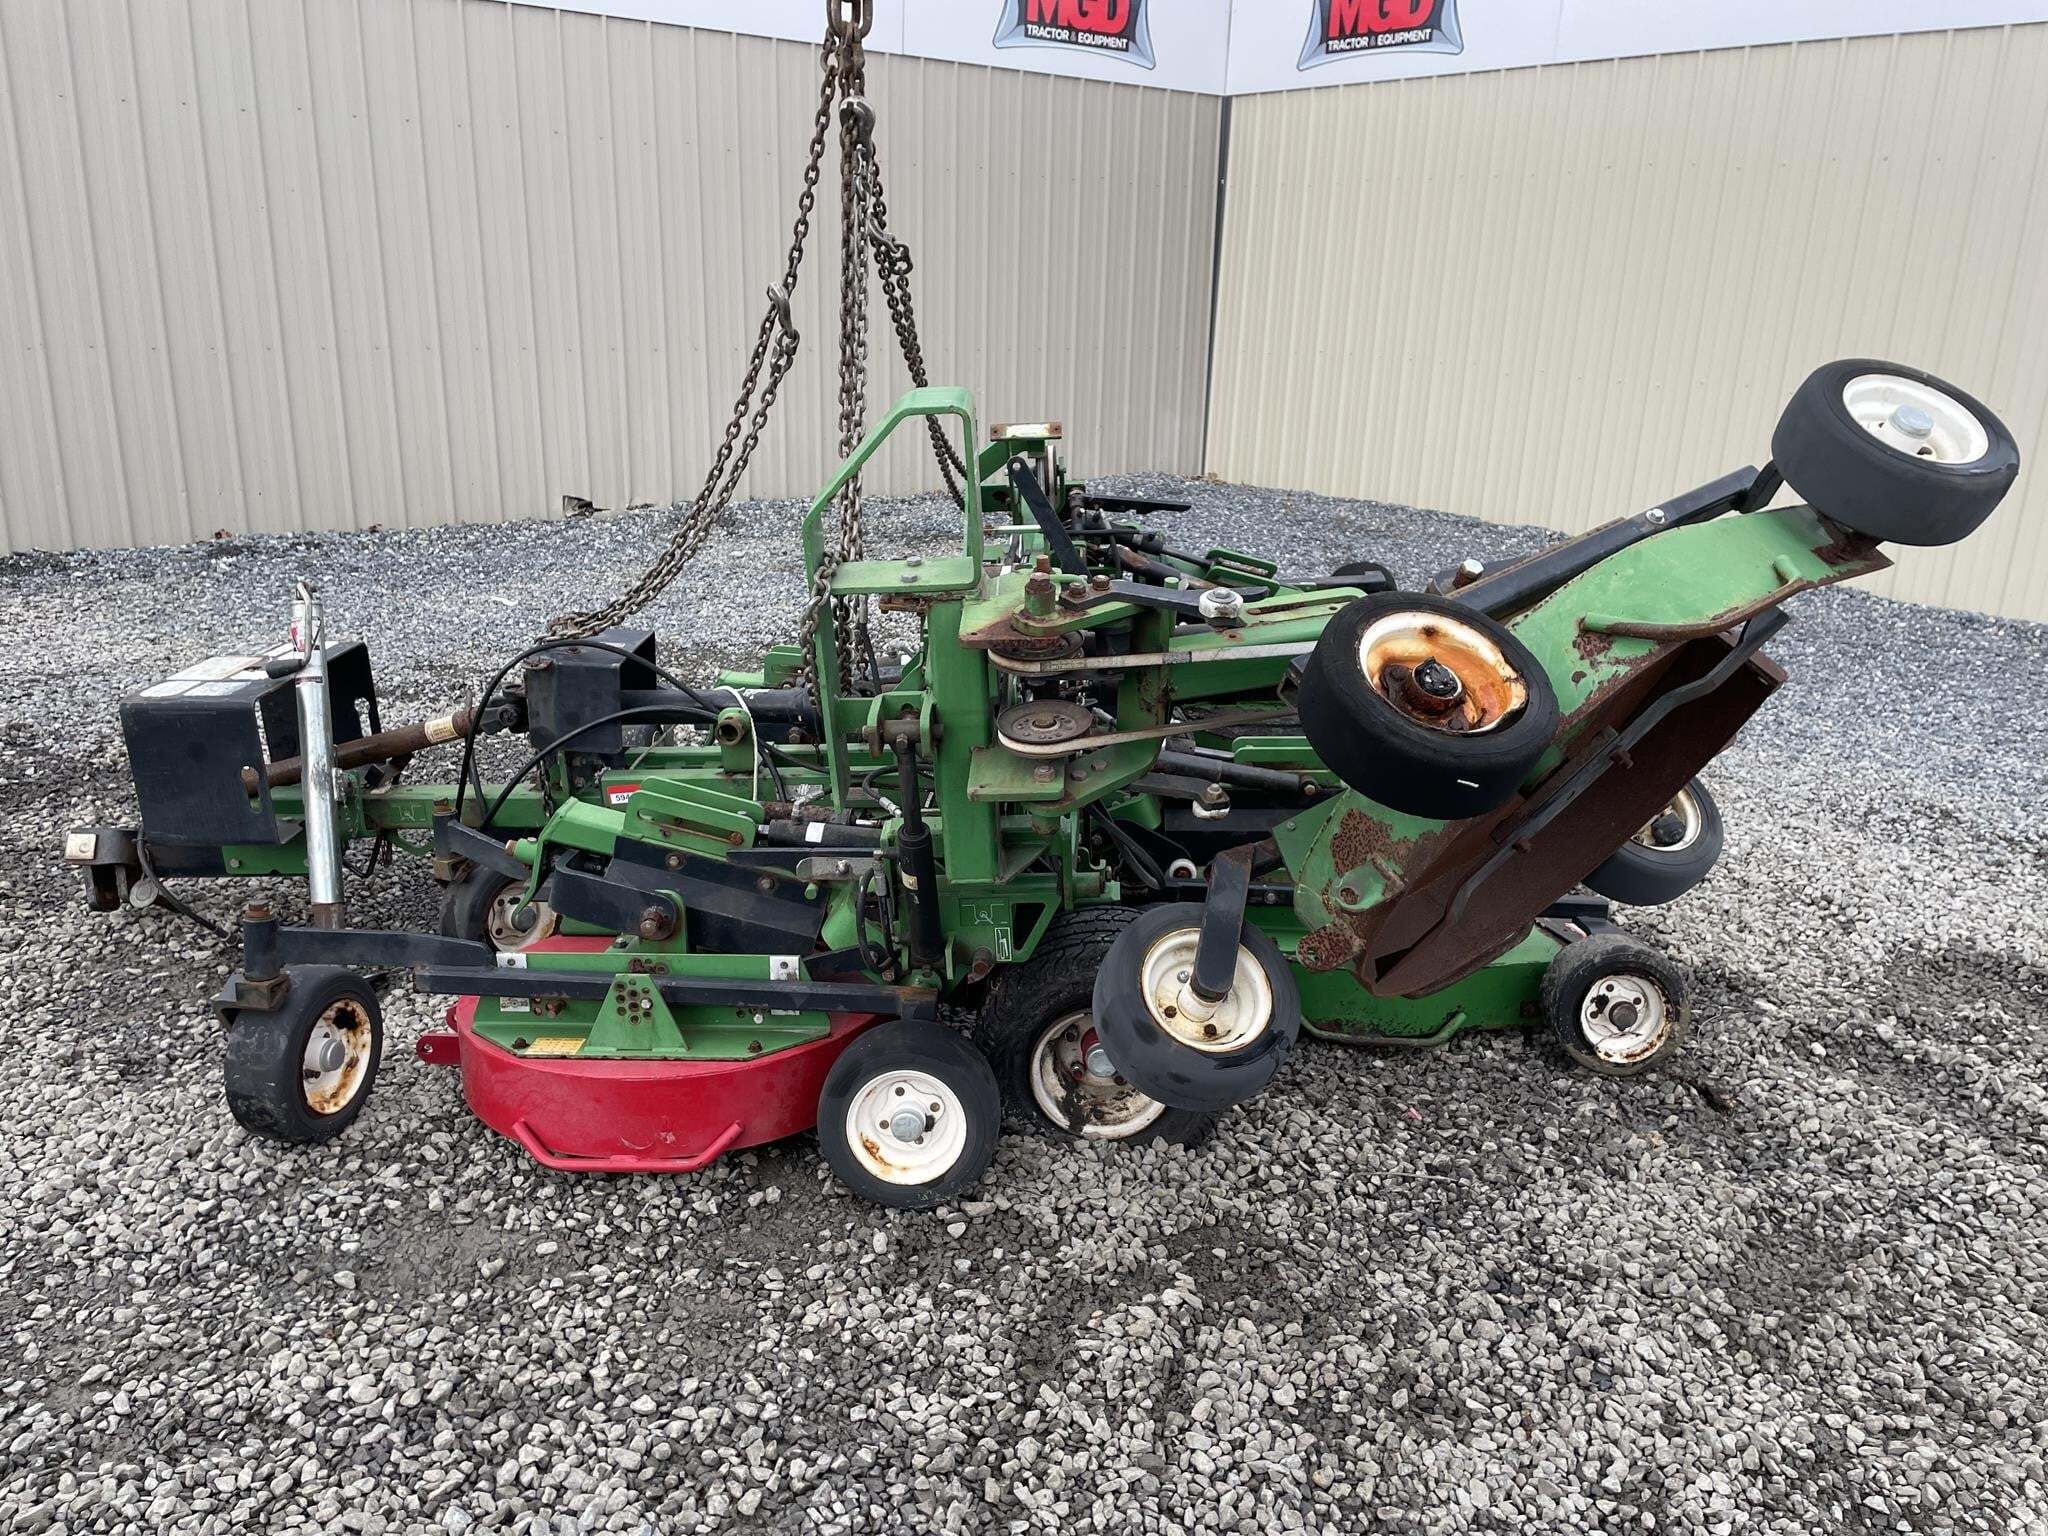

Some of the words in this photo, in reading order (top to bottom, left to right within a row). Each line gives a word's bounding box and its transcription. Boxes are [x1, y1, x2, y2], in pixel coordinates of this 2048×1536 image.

[1027, 24, 1070, 41] TRACTOR
[1070, 32, 1077, 42] &
[1077, 31, 1128, 49] EQUIPMENT
[1327, 36, 1369, 51] TRACTOR
[1369, 36, 1376, 47] &
[1377, 28, 1432, 46] EQUIPMENT
